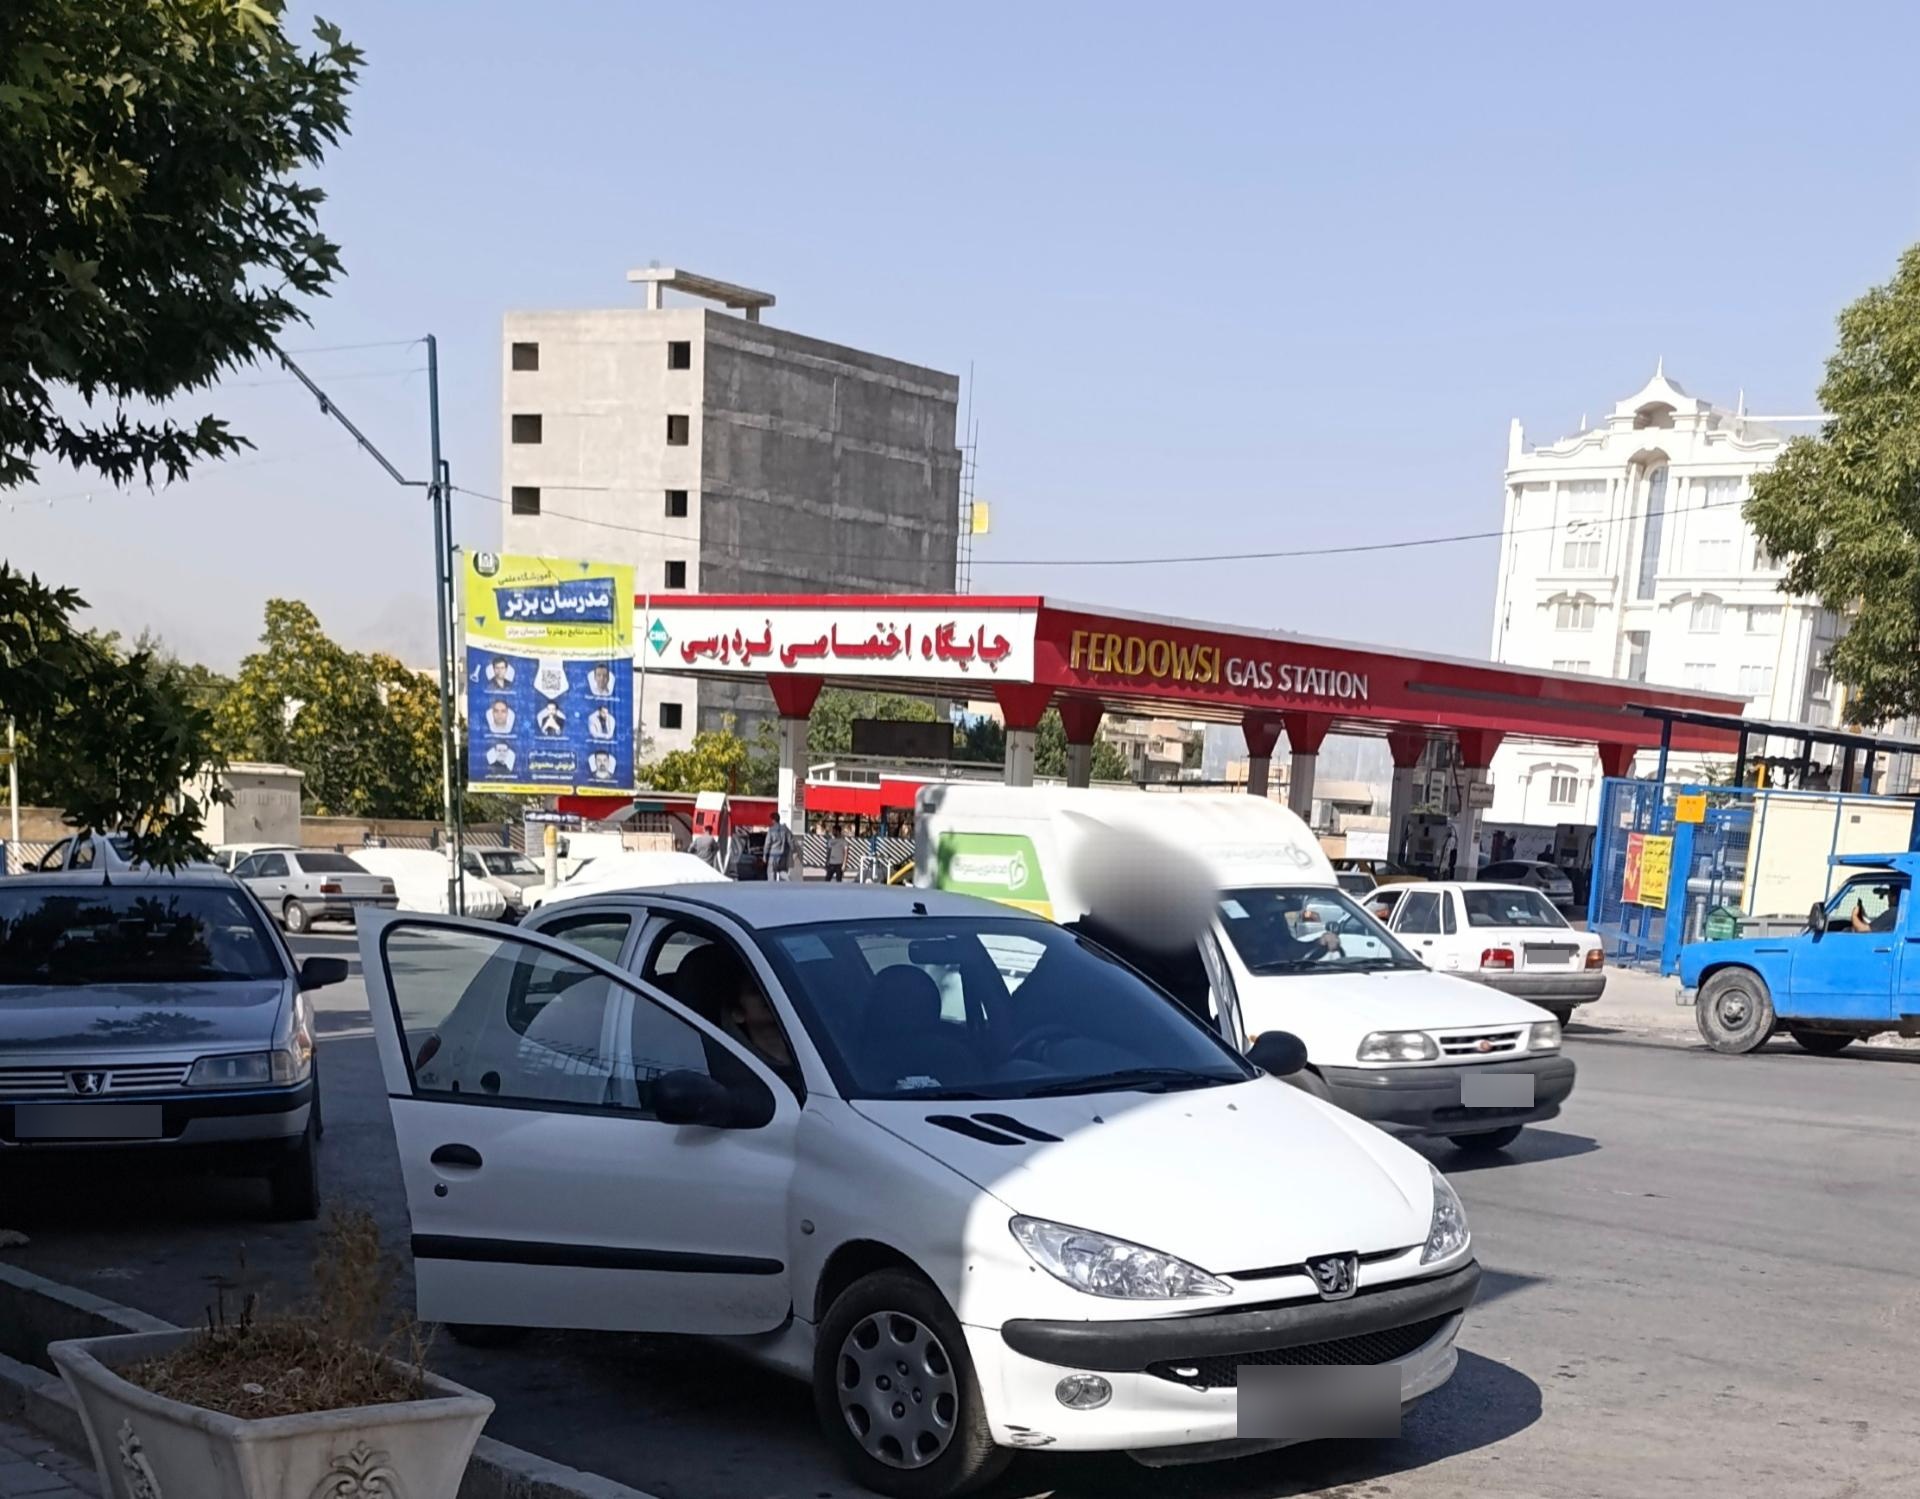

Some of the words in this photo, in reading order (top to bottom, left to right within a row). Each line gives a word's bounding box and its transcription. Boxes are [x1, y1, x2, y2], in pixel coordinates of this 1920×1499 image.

[504, 591, 539, 617] برتر
[541, 589, 609, 614] مدرسان
[650, 630, 667, 641] CNG
[681, 618, 774, 667] فردوسی
[780, 622, 912, 668] اختصاصی
[922, 621, 1012, 673] جایگاه
[1070, 630, 1221, 684] FERDOWSI
[1225, 657, 1273, 690] GAS
[1277, 664, 1369, 701] STATION
